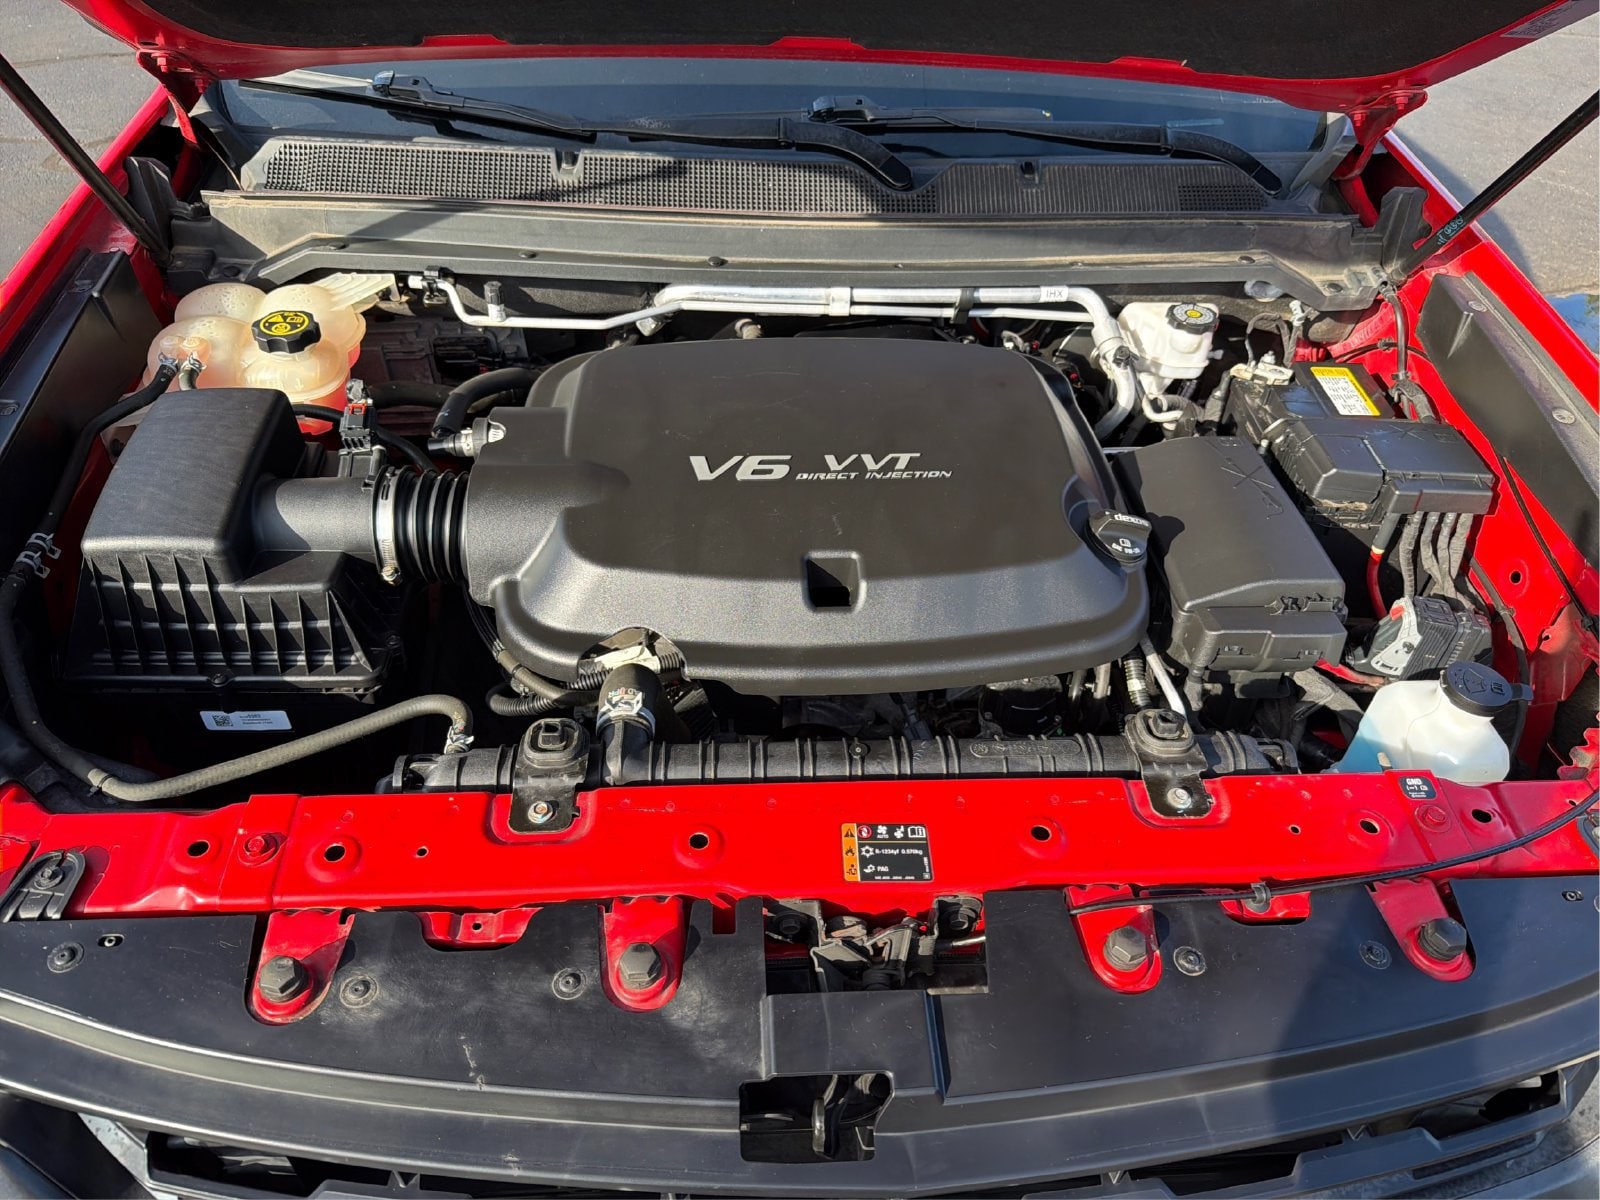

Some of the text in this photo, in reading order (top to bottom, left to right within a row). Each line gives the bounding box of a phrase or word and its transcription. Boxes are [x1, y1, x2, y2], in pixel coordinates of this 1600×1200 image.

[689, 453, 921, 482] V6 VVT
[795, 470, 953, 481] DIRECT INJECTION
